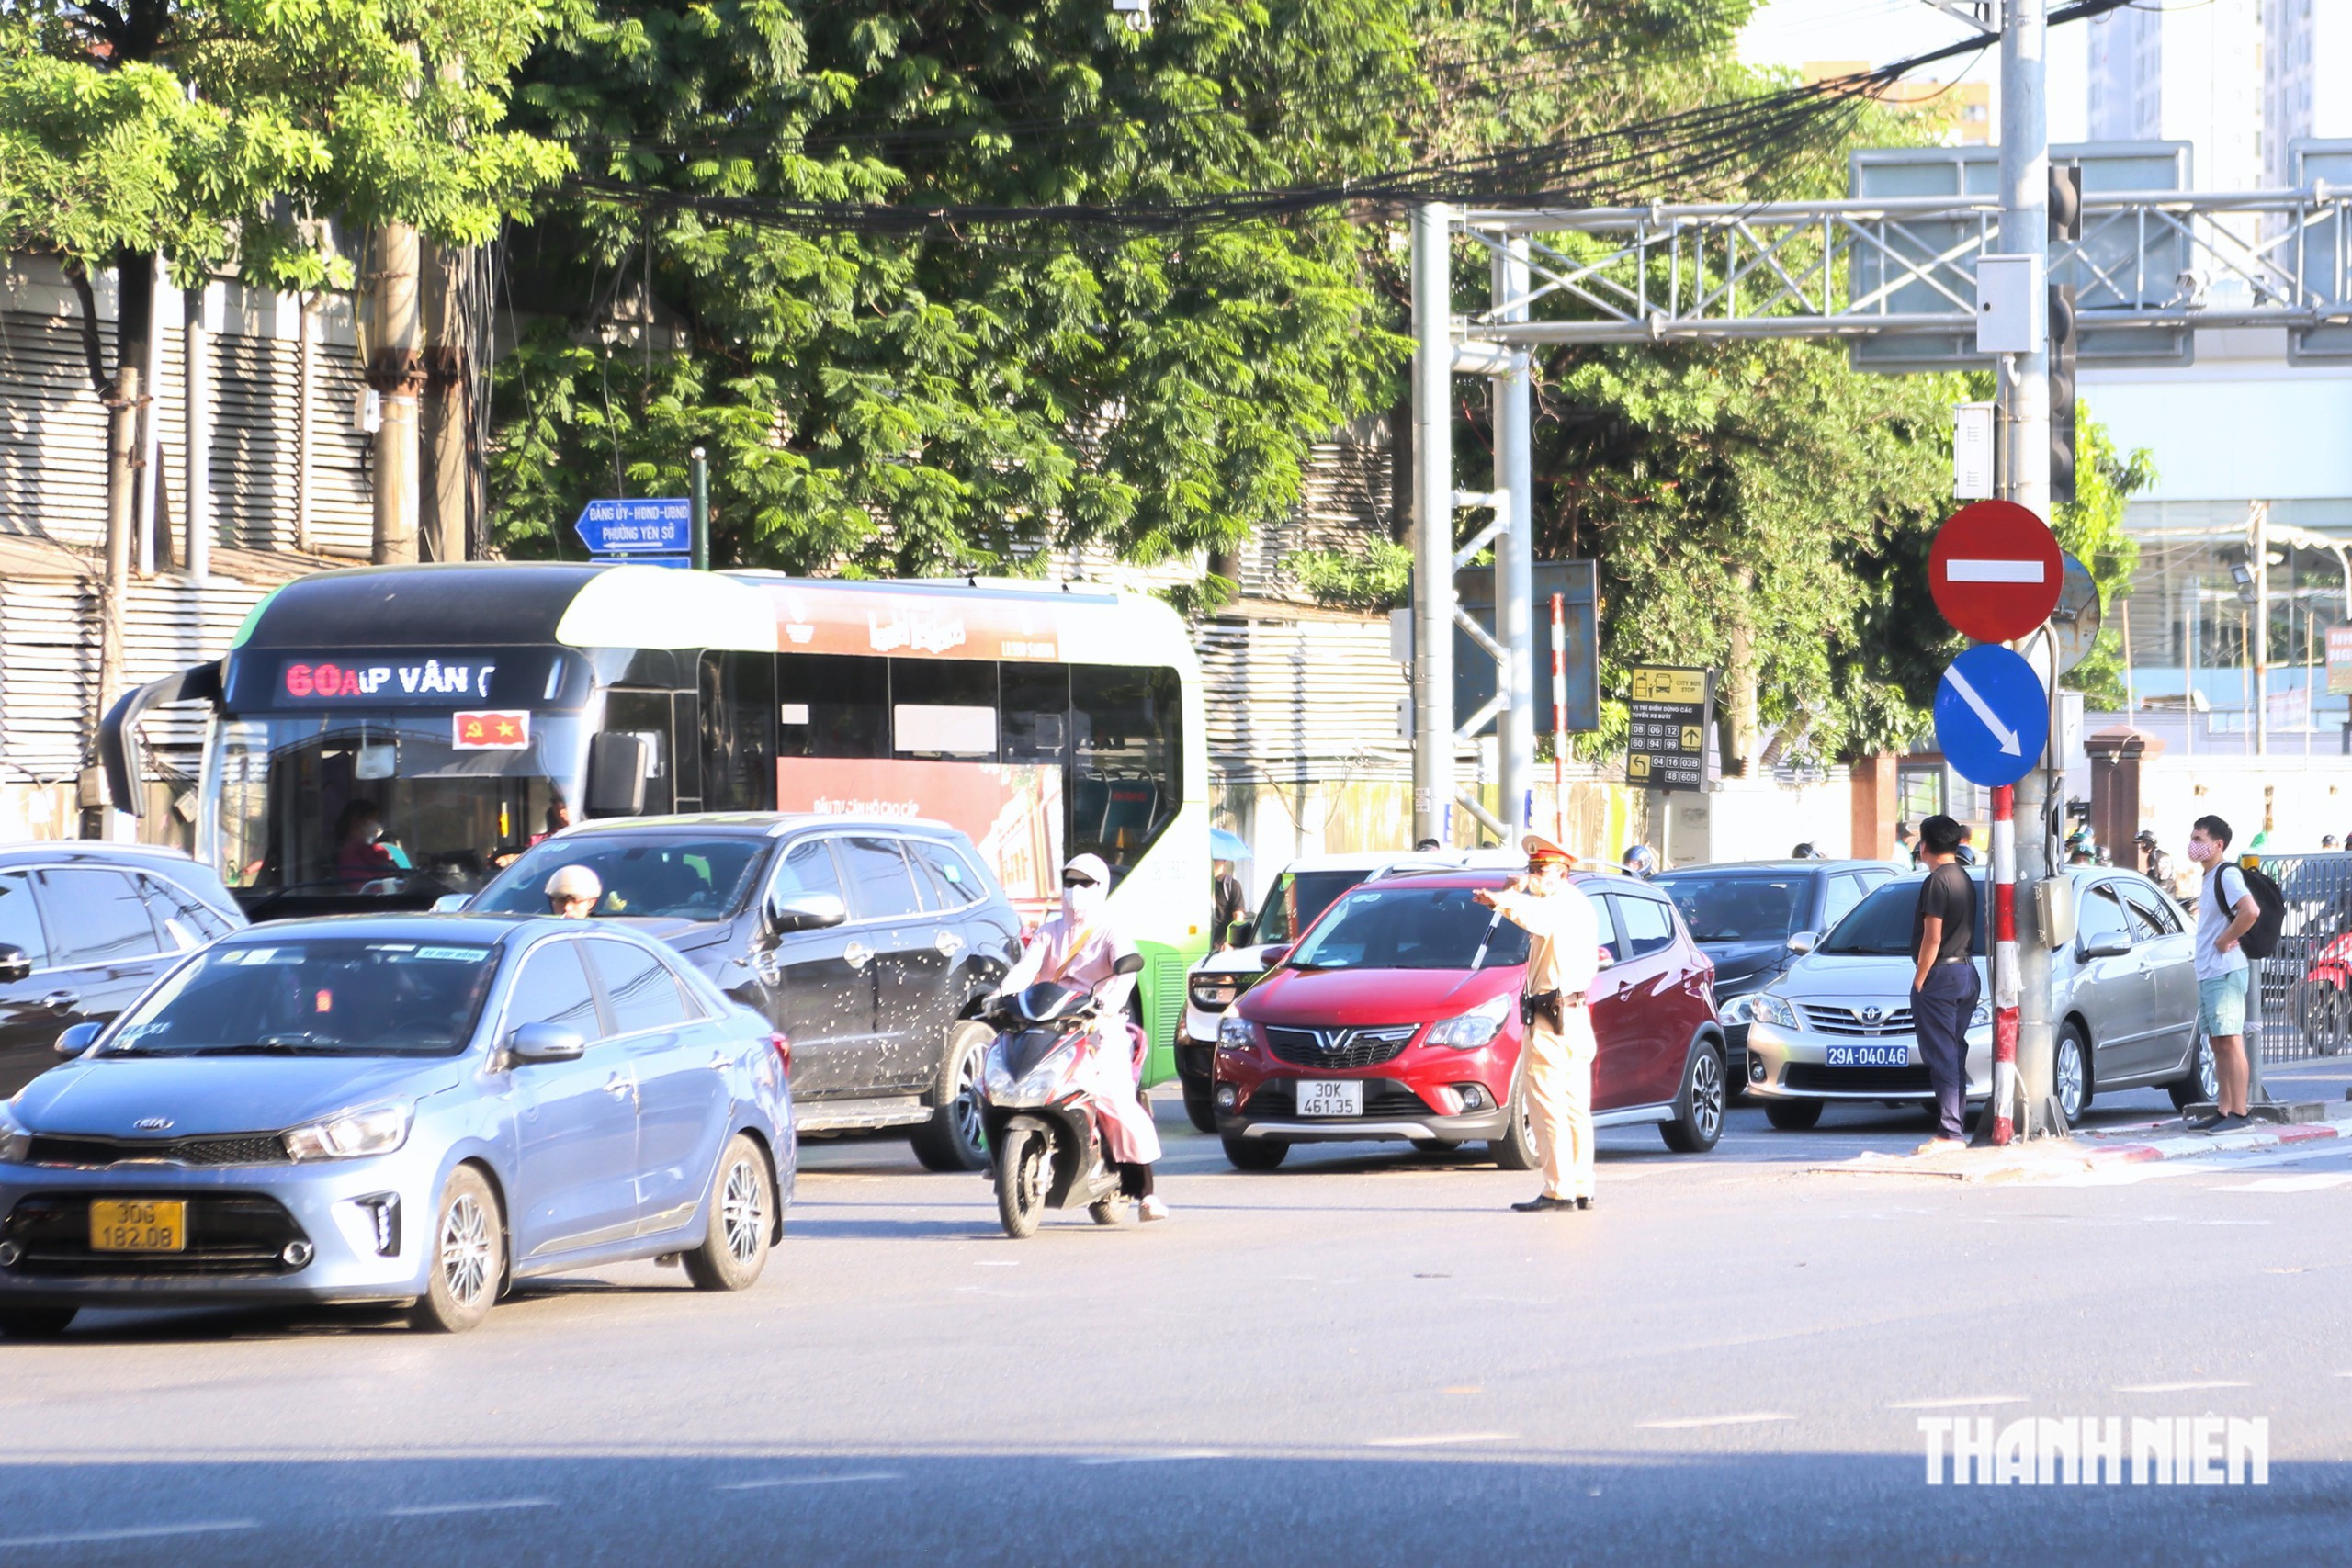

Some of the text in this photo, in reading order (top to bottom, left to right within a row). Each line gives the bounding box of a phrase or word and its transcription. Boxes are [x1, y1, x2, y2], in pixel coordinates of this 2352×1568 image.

[602, 522, 675, 541] PHƯỜNG YÊN SỞ
[399, 660, 469, 694] VÂN
[1828, 1048, 1906, 1065] 29A-040.46
[1315, 1083, 1341, 1098] 30K
[1304, 1099, 1353, 1114] 461.35
[117, 1203, 155, 1224] 30G
[103, 1226, 173, 1248] 182.08
